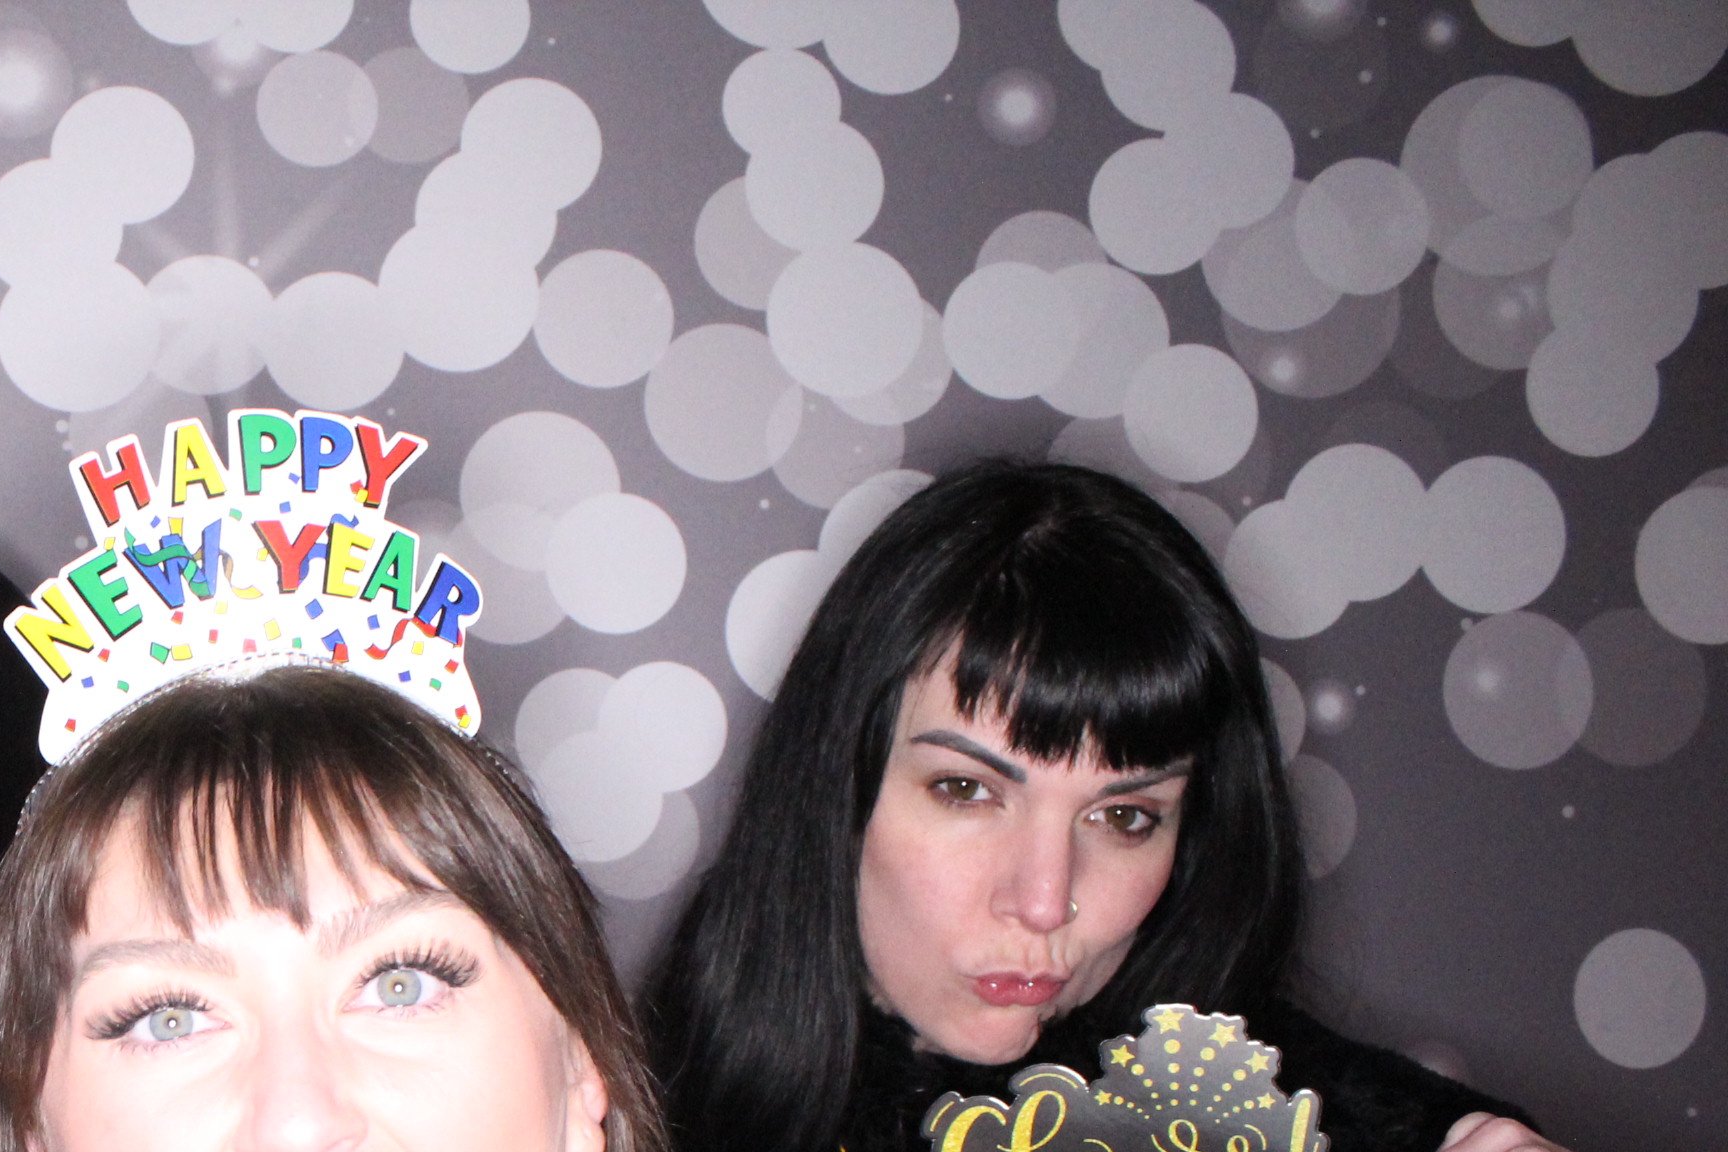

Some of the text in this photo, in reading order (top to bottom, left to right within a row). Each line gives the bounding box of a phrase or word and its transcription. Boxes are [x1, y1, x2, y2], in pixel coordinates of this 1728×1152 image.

[80, 413, 420, 526] HAPPY
[15, 518, 480, 682] NEW YEAR
